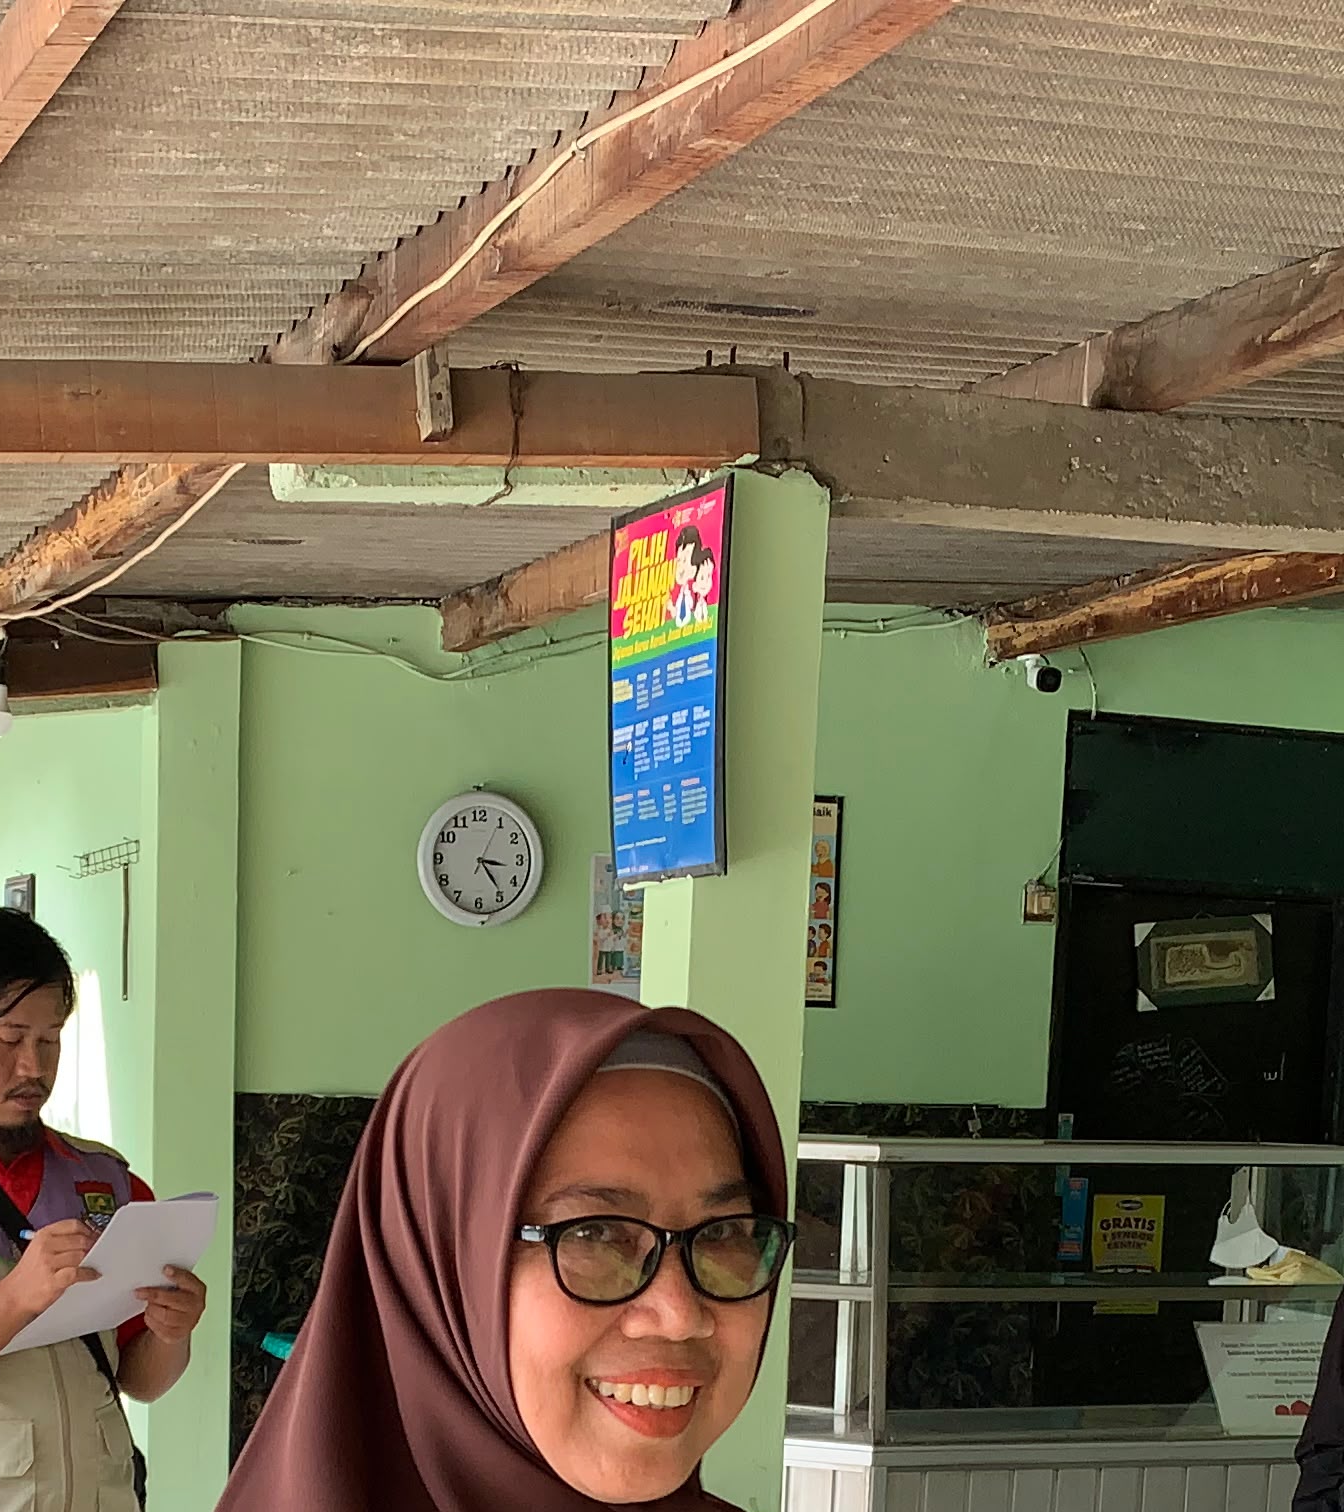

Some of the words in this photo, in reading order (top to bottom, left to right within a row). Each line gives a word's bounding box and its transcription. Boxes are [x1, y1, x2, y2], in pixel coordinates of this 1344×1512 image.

[628, 529, 669, 574] PILIH
[613, 558, 677, 610] JAJANAN
[623, 594, 669, 640] SEHAT
[471, 809, 487, 822] 12
[813, 806, 832, 817] aik
[452, 816, 468, 828] 11
[496, 817, 504, 829] 1
[439, 831, 456, 843] 10
[510, 832, 519, 844] 2
[433, 852, 443, 865] 9
[515, 854, 524, 866] 3
[438, 874, 449, 886] 8
[509, 875, 518, 887] 4
[453, 890, 462, 902] 7
[495, 891, 504, 903] 5
[474, 897, 483, 909] 6
[1099, 1217, 1156, 1231] GRATIS
